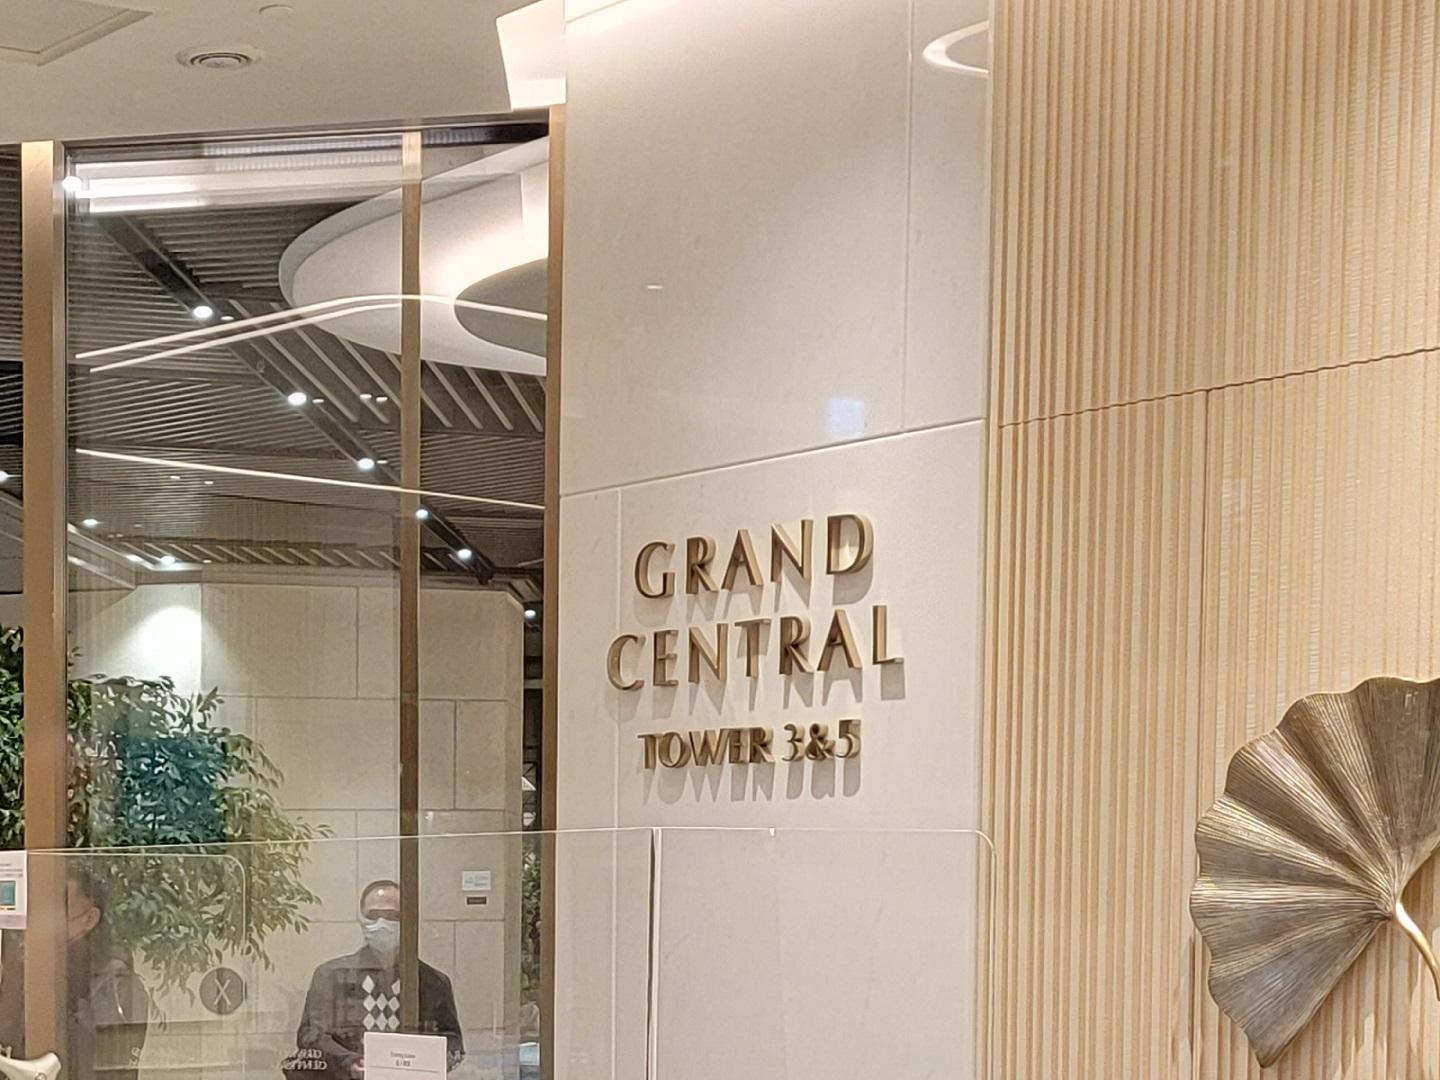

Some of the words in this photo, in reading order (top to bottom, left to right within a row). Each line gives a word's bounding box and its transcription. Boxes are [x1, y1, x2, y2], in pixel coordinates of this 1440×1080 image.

[634, 513, 874, 599] GRAND
[607, 604, 905, 691] CENTRAL
[638, 726, 776, 770] TOWER
[782, 718, 862, 762] 3&5
